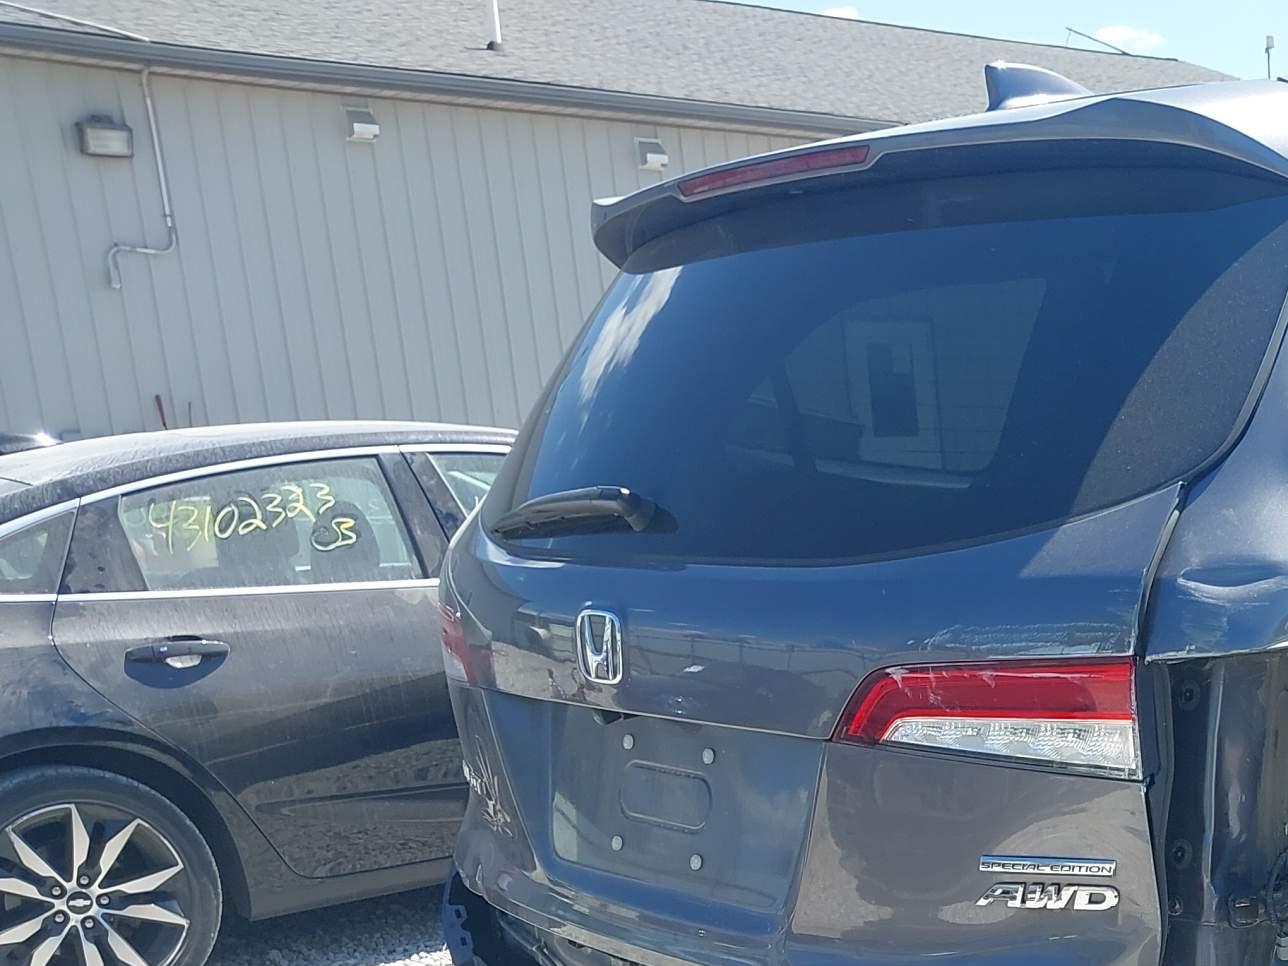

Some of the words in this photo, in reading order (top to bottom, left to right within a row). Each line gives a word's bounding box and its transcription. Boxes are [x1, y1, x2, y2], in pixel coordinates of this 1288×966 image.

[980, 861, 1046, 872] SPECIAL
[1049, 864, 1113, 874] EDITION
[975, 882, 1120, 911] AWD
